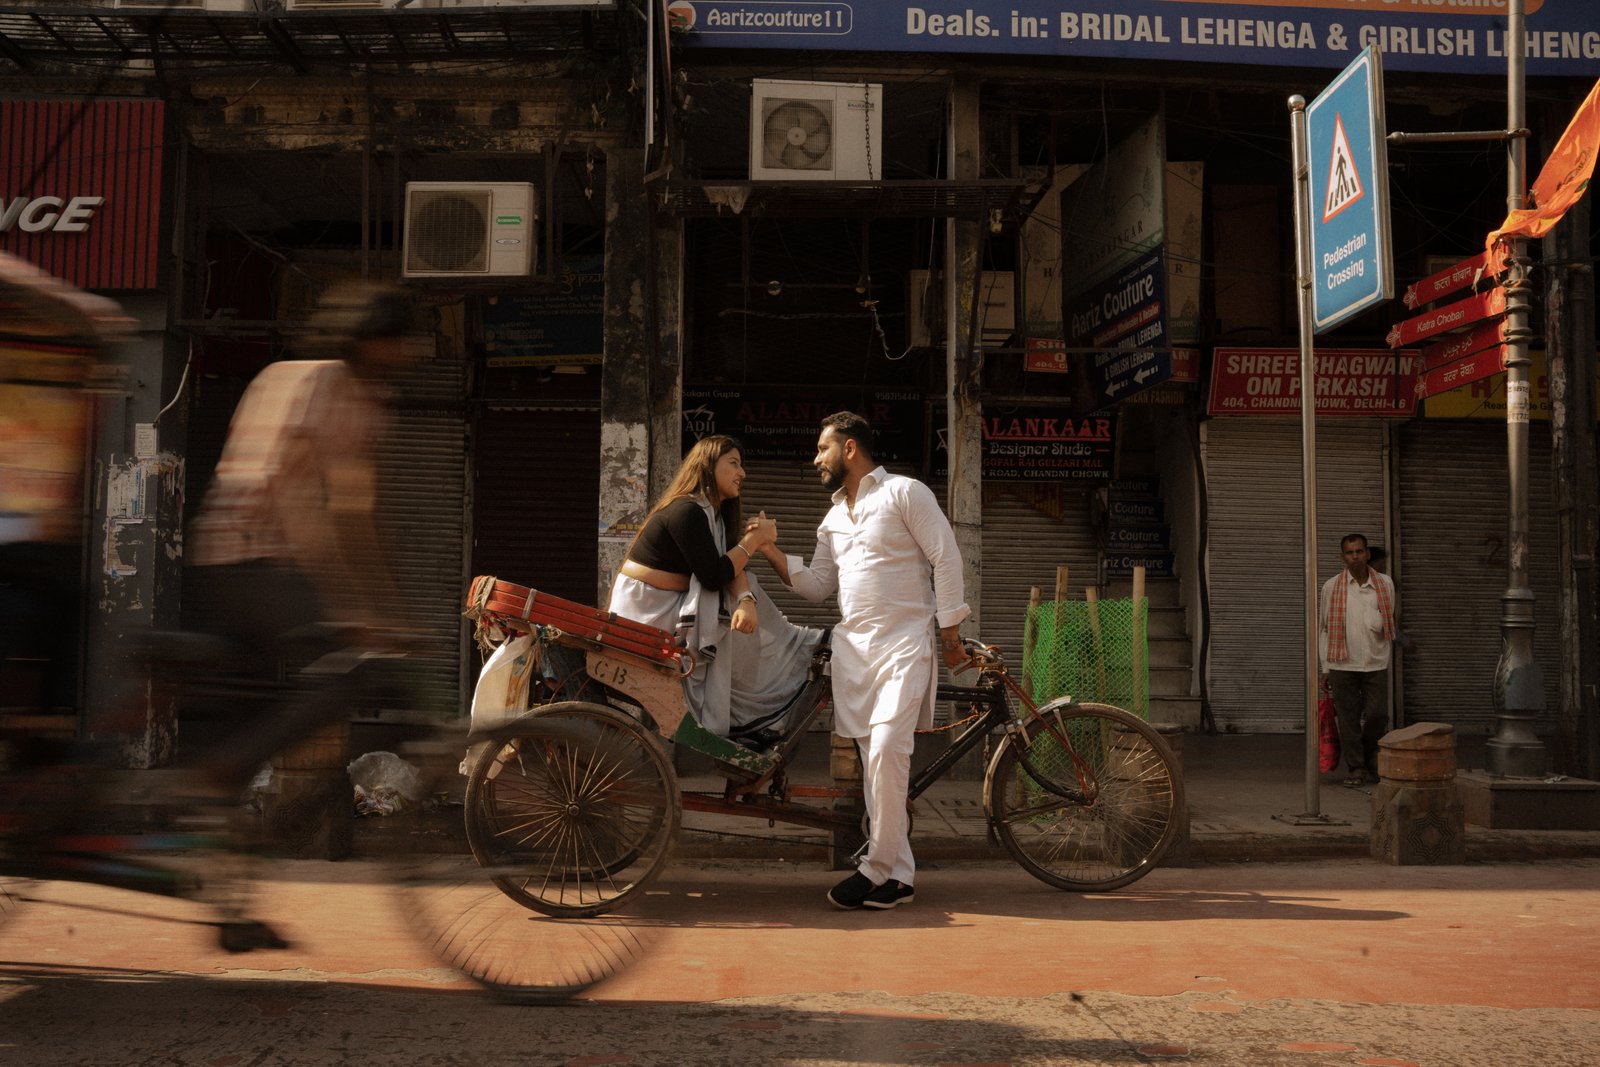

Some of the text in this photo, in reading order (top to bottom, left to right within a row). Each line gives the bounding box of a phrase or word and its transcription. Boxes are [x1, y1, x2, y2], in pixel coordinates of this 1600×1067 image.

[707, 8, 843, 28] Aarizcouture11
[907, 8, 1000, 37] Deals.
[1011, 10, 1048, 38] in:
[1060, 12, 1170, 43] BRIDAL
[1181, 17, 1316, 49] LEHENGA
[1327, 23, 1348, 51] &
[1359, 25, 1475, 56] GIRLISH
[1323, 232, 1366, 270] Pedestrian
[1327, 258, 1364, 290] Crossing
[1072, 273, 1154, 338] Aariz Couture
[1417, 310, 1465, 333] Katra Choban
[1137, 320, 1163, 346] LEHENGA
[1226, 355, 1299, 374] SHREE
[713, 391, 740, 400] Gupta
[1246, 377, 1388, 397] OM PRKASH
[736, 400, 893, 424] ALANKAR
[1222, 397, 1247, 410] 404,
[1314, 398, 1350, 410] HOWK,
[745, 425, 789, 435] Designer
[990, 442, 1092, 457] Designer Studio
[984, 458, 1103, 468] GOPAL RAI GULZARI MAL
[990, 469, 1021, 479] ROAD,
[1024, 470, 1069, 478] CHANDNI
[1072, 470, 1109, 479] CHOWK
[1109, 480, 1150, 491] Couture
[1115, 502, 1155, 515] Couture
[1119, 529, 1160, 541] Couture
[1122, 556, 1164, 568] Couture
